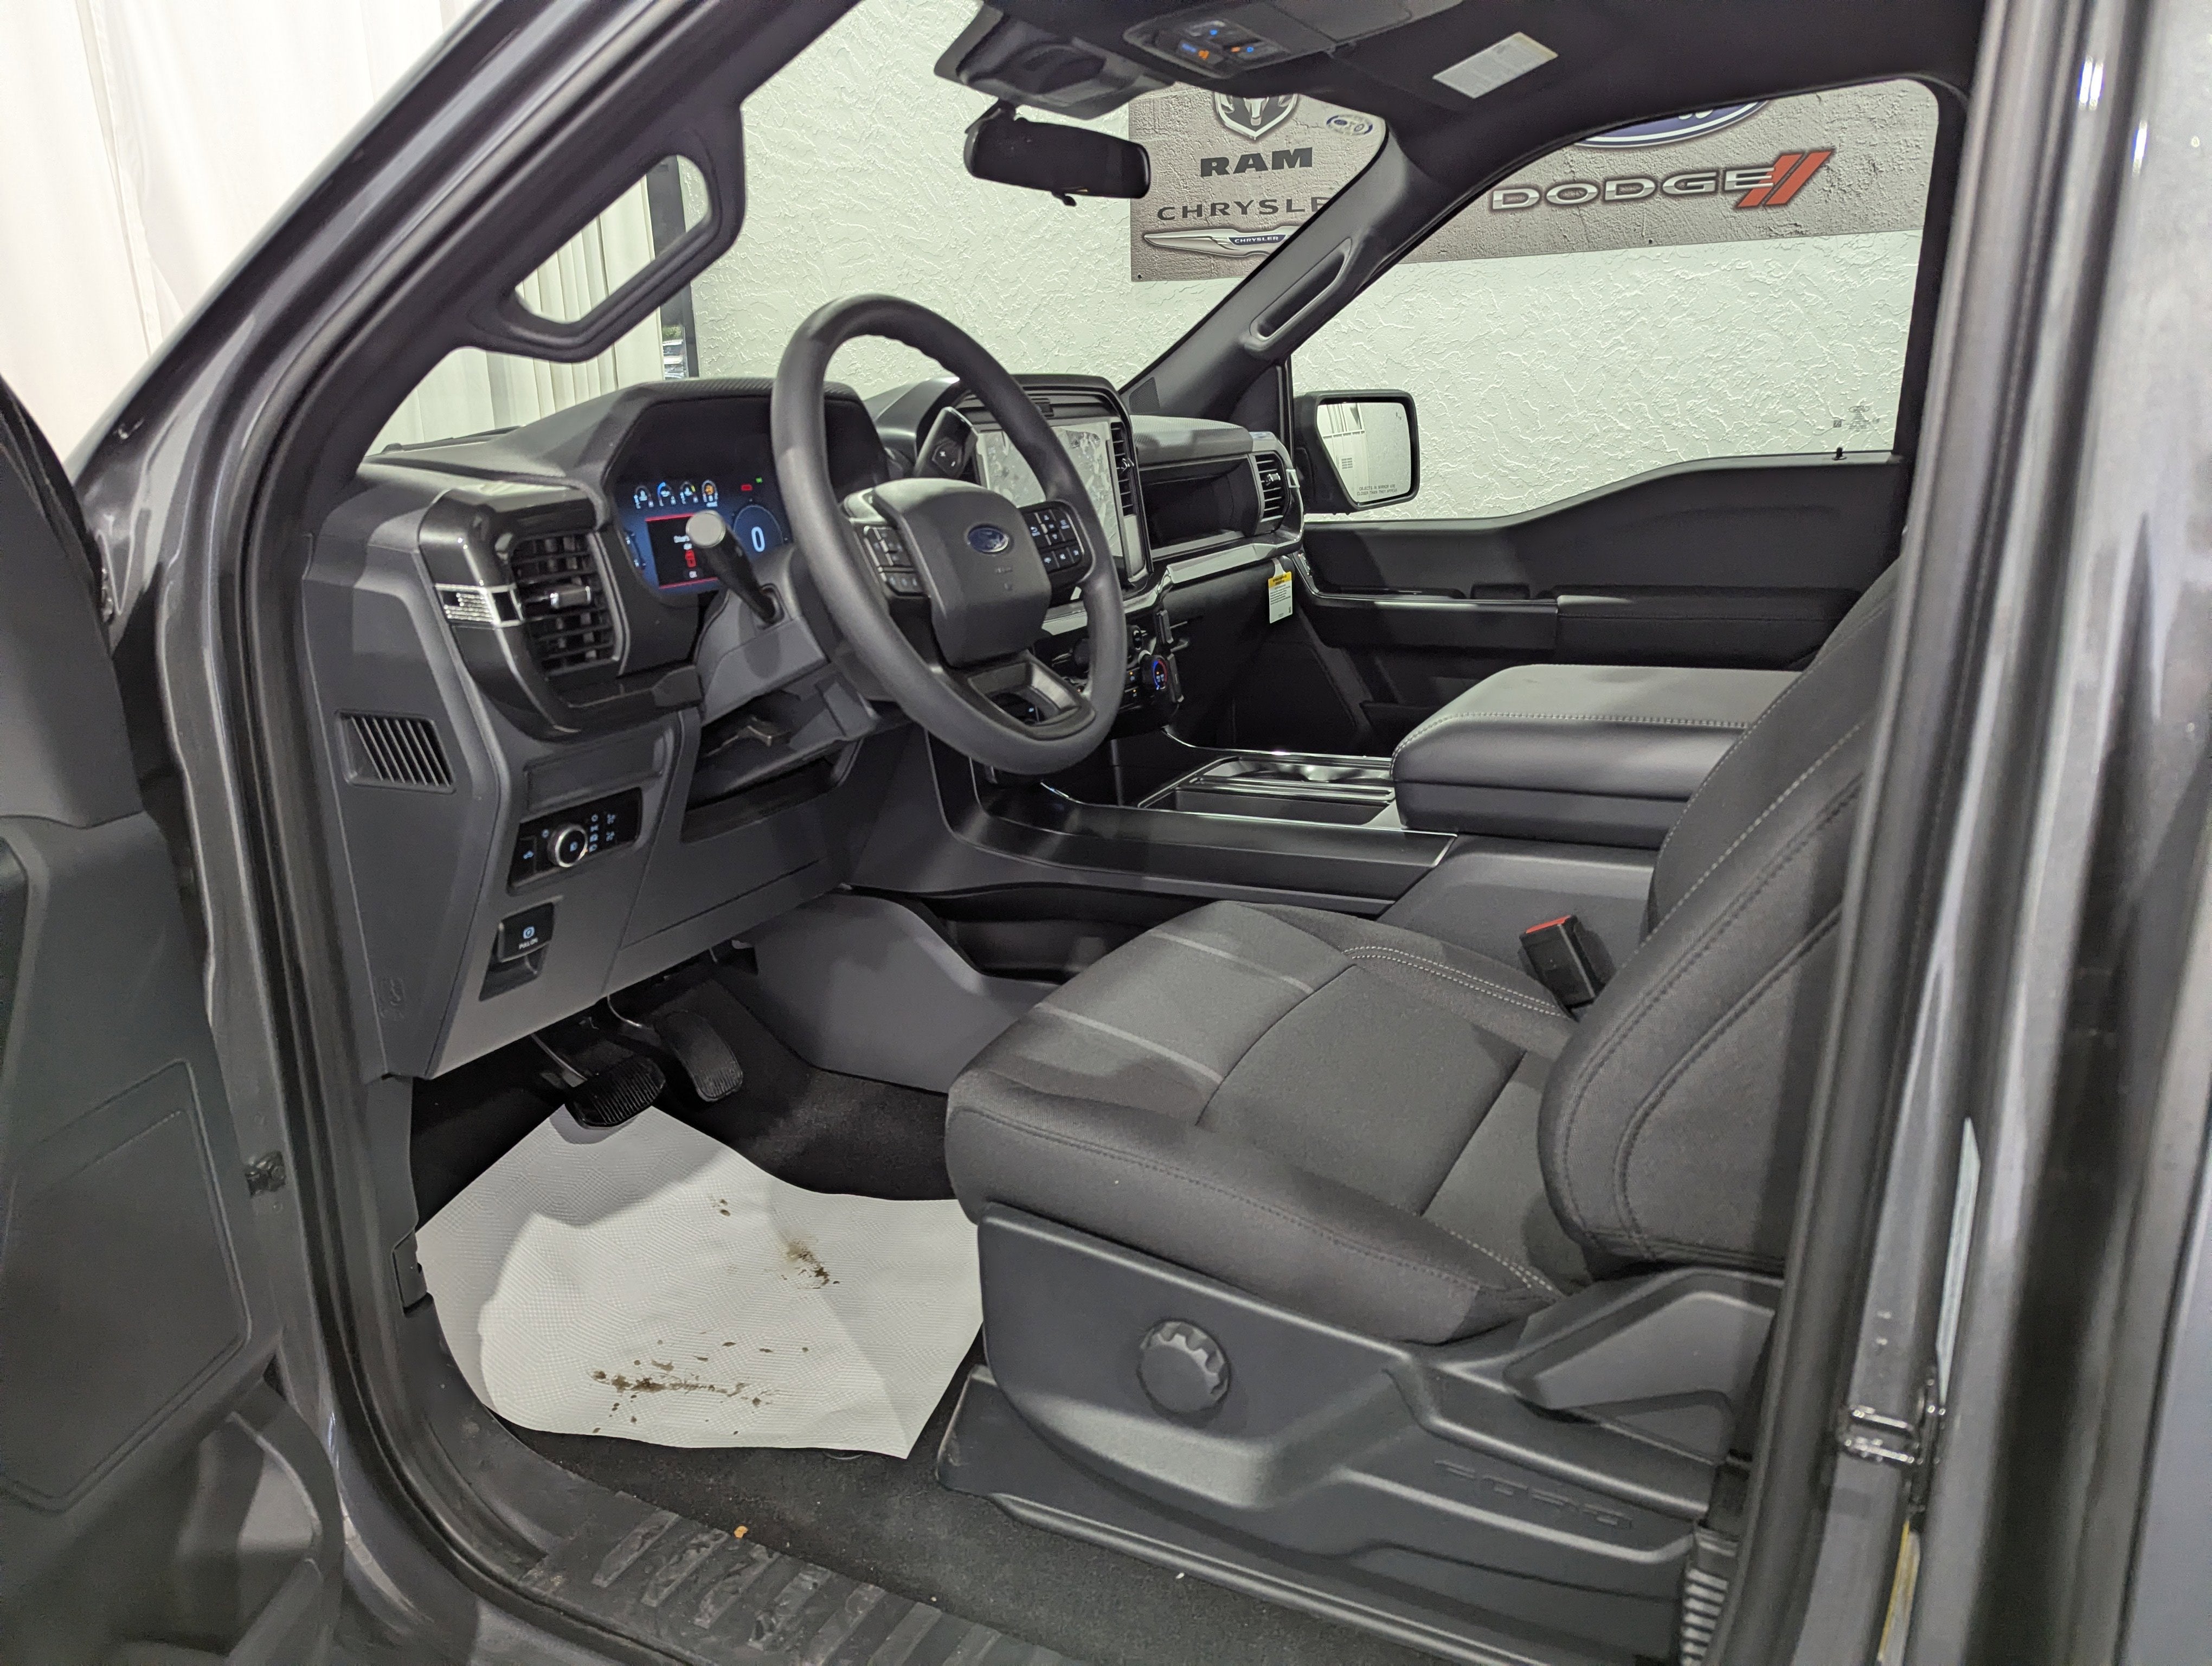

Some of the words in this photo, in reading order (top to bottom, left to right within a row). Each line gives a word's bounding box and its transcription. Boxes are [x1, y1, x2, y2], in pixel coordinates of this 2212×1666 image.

[1200, 147, 1313, 177] RAM
[1490, 166, 1776, 211] DODGE
[1158, 196, 1330, 221] CHRYSLE
[751, 526, 765, 552] 0
